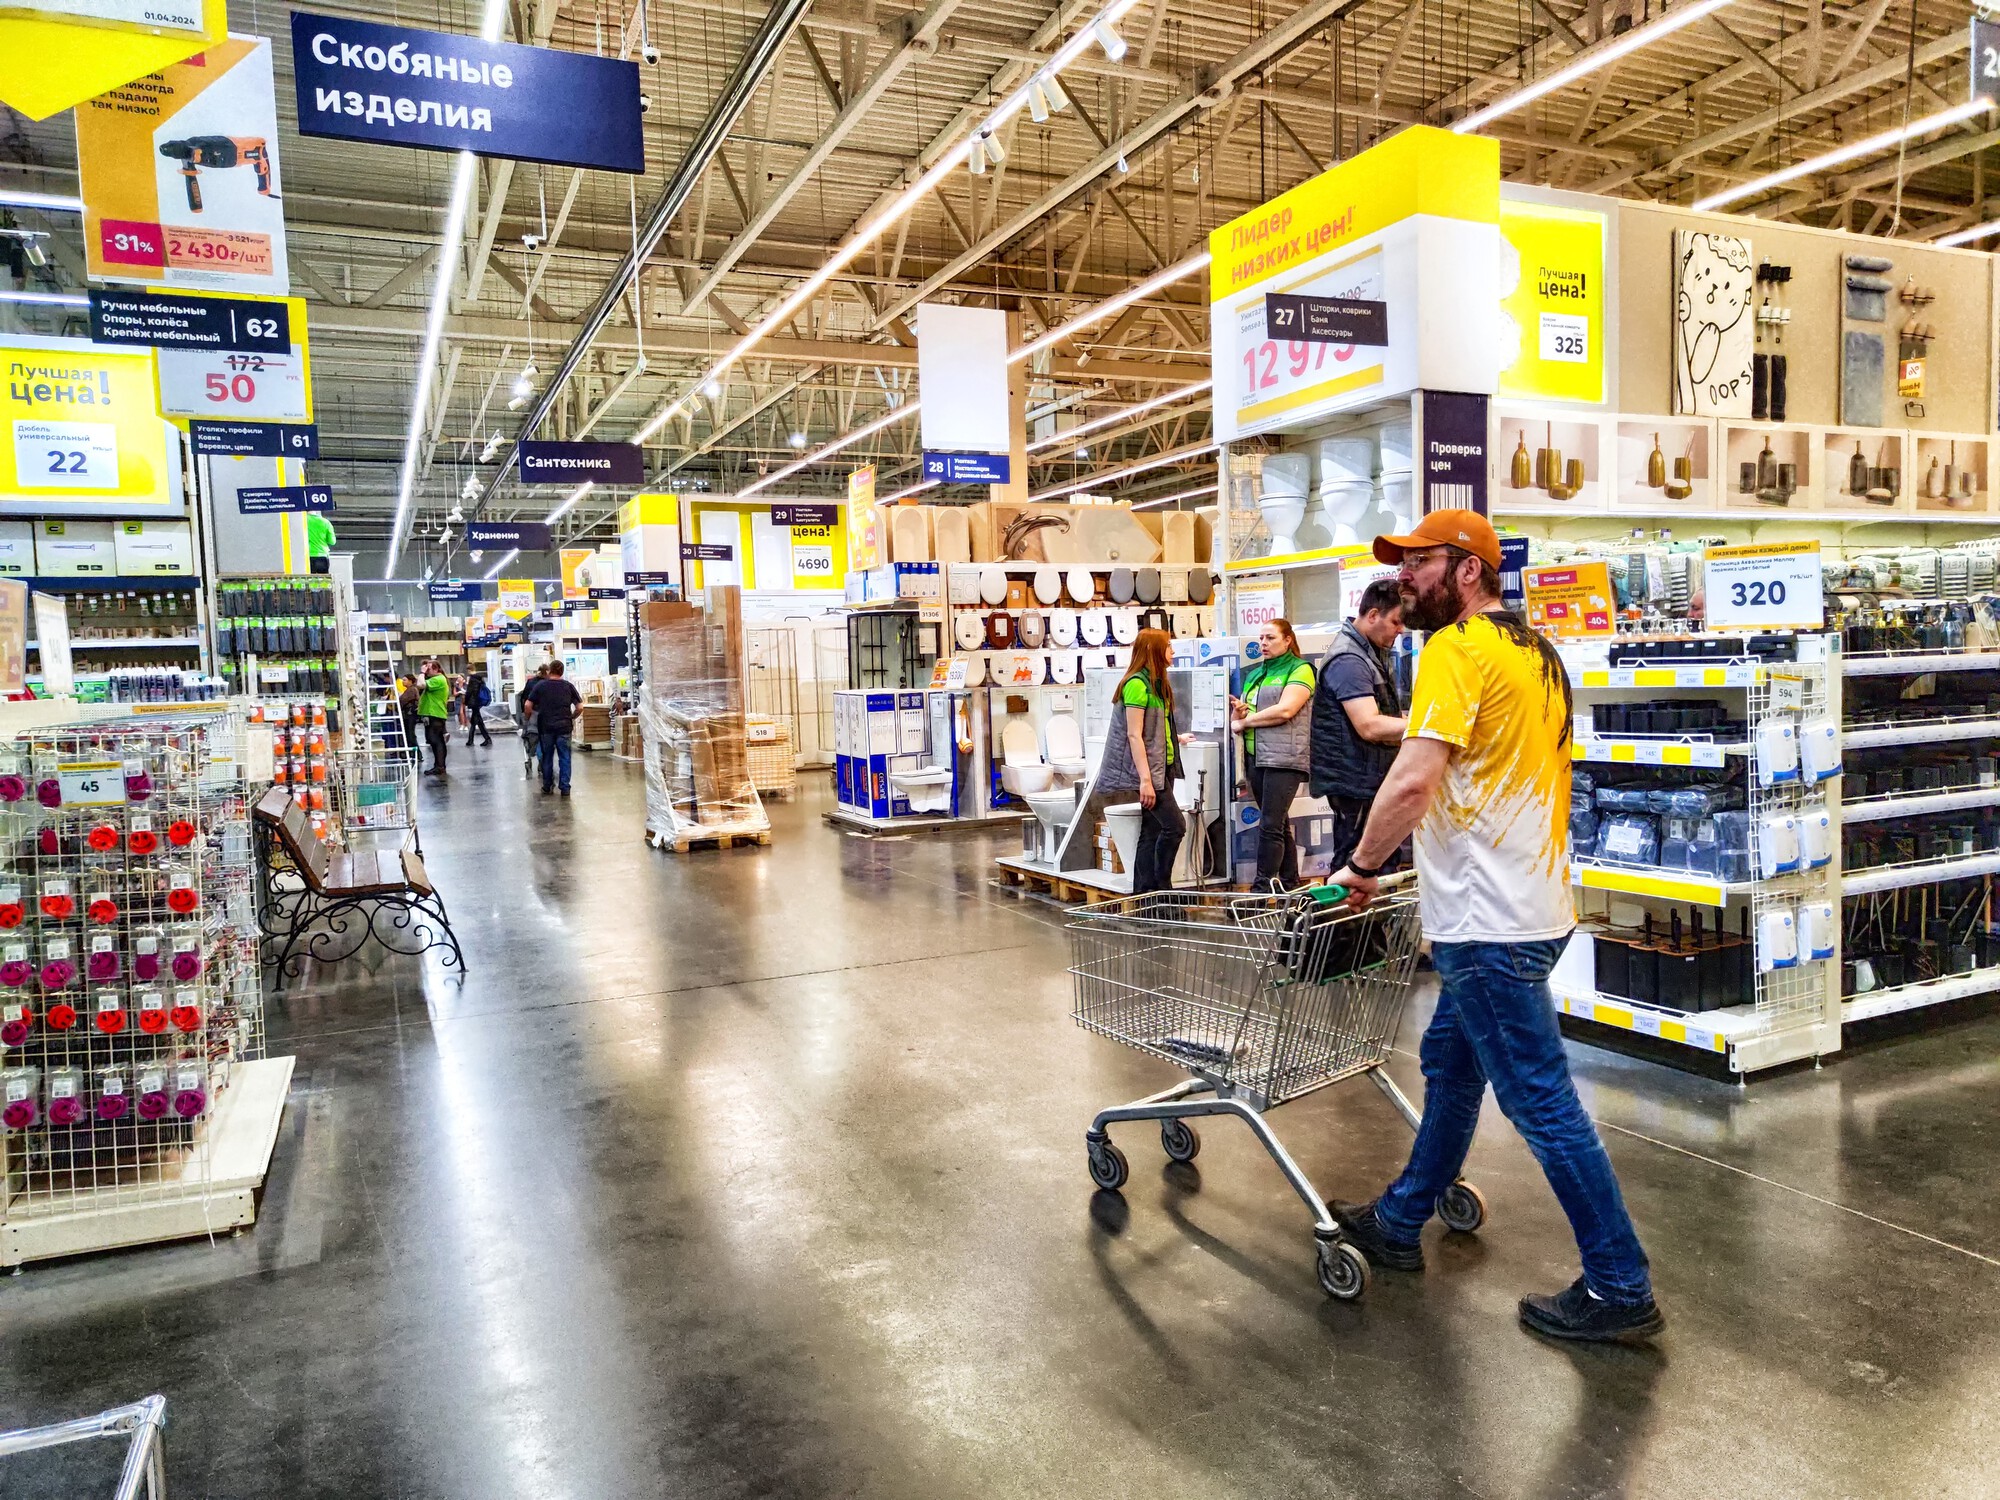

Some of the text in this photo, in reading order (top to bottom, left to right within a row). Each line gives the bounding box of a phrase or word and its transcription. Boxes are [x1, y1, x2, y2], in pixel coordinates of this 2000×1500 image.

[144, 11, 195, 25] 01.04.2024
[312, 33, 513, 89] Скобяные
[1983, 46, 2000, 78] 2
[110, 91, 158, 104] падали
[91, 100, 160, 116] так низко!
[315, 87, 492, 132] изделия
[1229, 206, 1293, 253] Лидер
[105, 233, 154, 253] -31%
[1230, 207, 1353, 285] низких цен!
[1538, 266, 1579, 280] Лучшая
[1538, 273, 1586, 299] цена!
[101, 300, 207, 316] Ручки мебельные
[1310, 303, 1372, 316] Шторки, коврики
[102, 314, 189, 328] Опоры, колёса
[1274, 308, 1295, 326] 27
[1310, 315, 1329, 324] Баня
[103, 327, 221, 342] Крепёж мебельный
[246, 318, 278, 338] 62
[1311, 327, 1353, 337] Аксессуары
[1555, 336, 1584, 355] 325
[227, 354, 265, 372] 172
[1243, 340, 1279, 393] 12
[10, 363, 93, 382] Лучшая
[10, 371, 111, 406] цена!
[205, 373, 255, 403] 50
[18, 425, 50, 433] Дюбель
[197, 425, 227, 434] Уголки,
[18, 434, 91, 442] универсальный
[292, 435, 310, 448] 61
[1430, 442, 1483, 457] Проверка
[47, 450, 88, 474] 22
[525, 455, 611, 469] Сантехника
[929, 461, 944, 472] 28
[1430, 460, 1452, 473] цен
[311, 493, 328, 503] 60
[775, 511, 788, 520] 29
[472, 531, 520, 541] Хранение
[793, 525, 830, 539] цена!
[1500, 544, 1525, 552] роверка
[1712, 543, 1811, 557] Низкие цены каждый день!
[798, 558, 829, 569] 4690
[1731, 580, 1786, 607] 320
[1240, 606, 1276, 625] 16500
[1778, 688, 1793, 698] 594
[81, 781, 99, 793] 45
